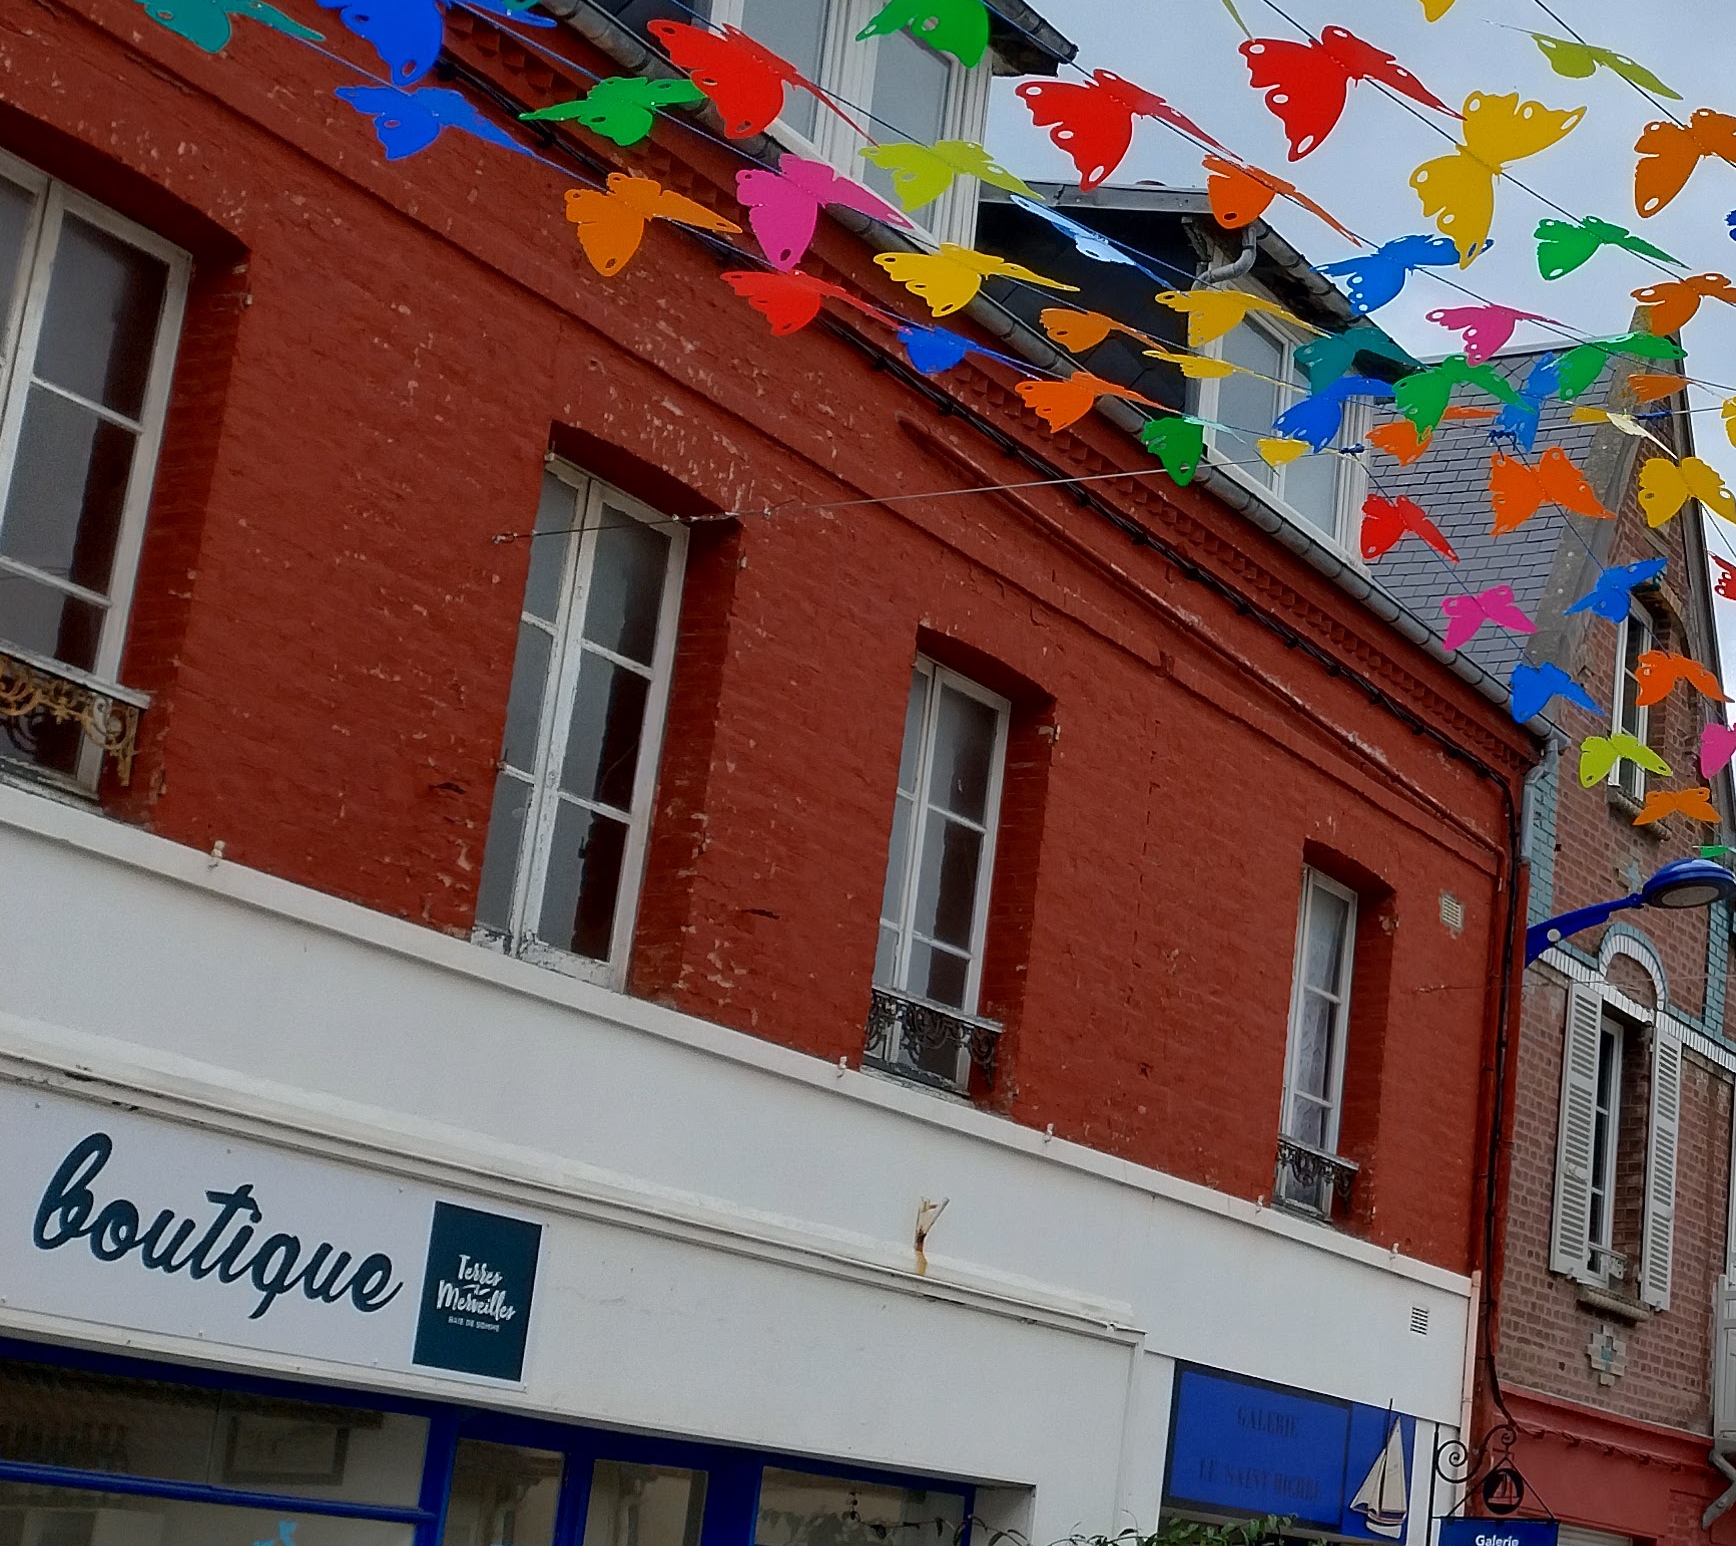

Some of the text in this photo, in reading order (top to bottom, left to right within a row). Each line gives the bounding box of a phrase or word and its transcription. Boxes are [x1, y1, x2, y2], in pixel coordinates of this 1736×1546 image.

[33, 1132, 404, 1320] boutique
[458, 1254, 504, 1287] Terres
[436, 1279, 517, 1322] Merveilles
